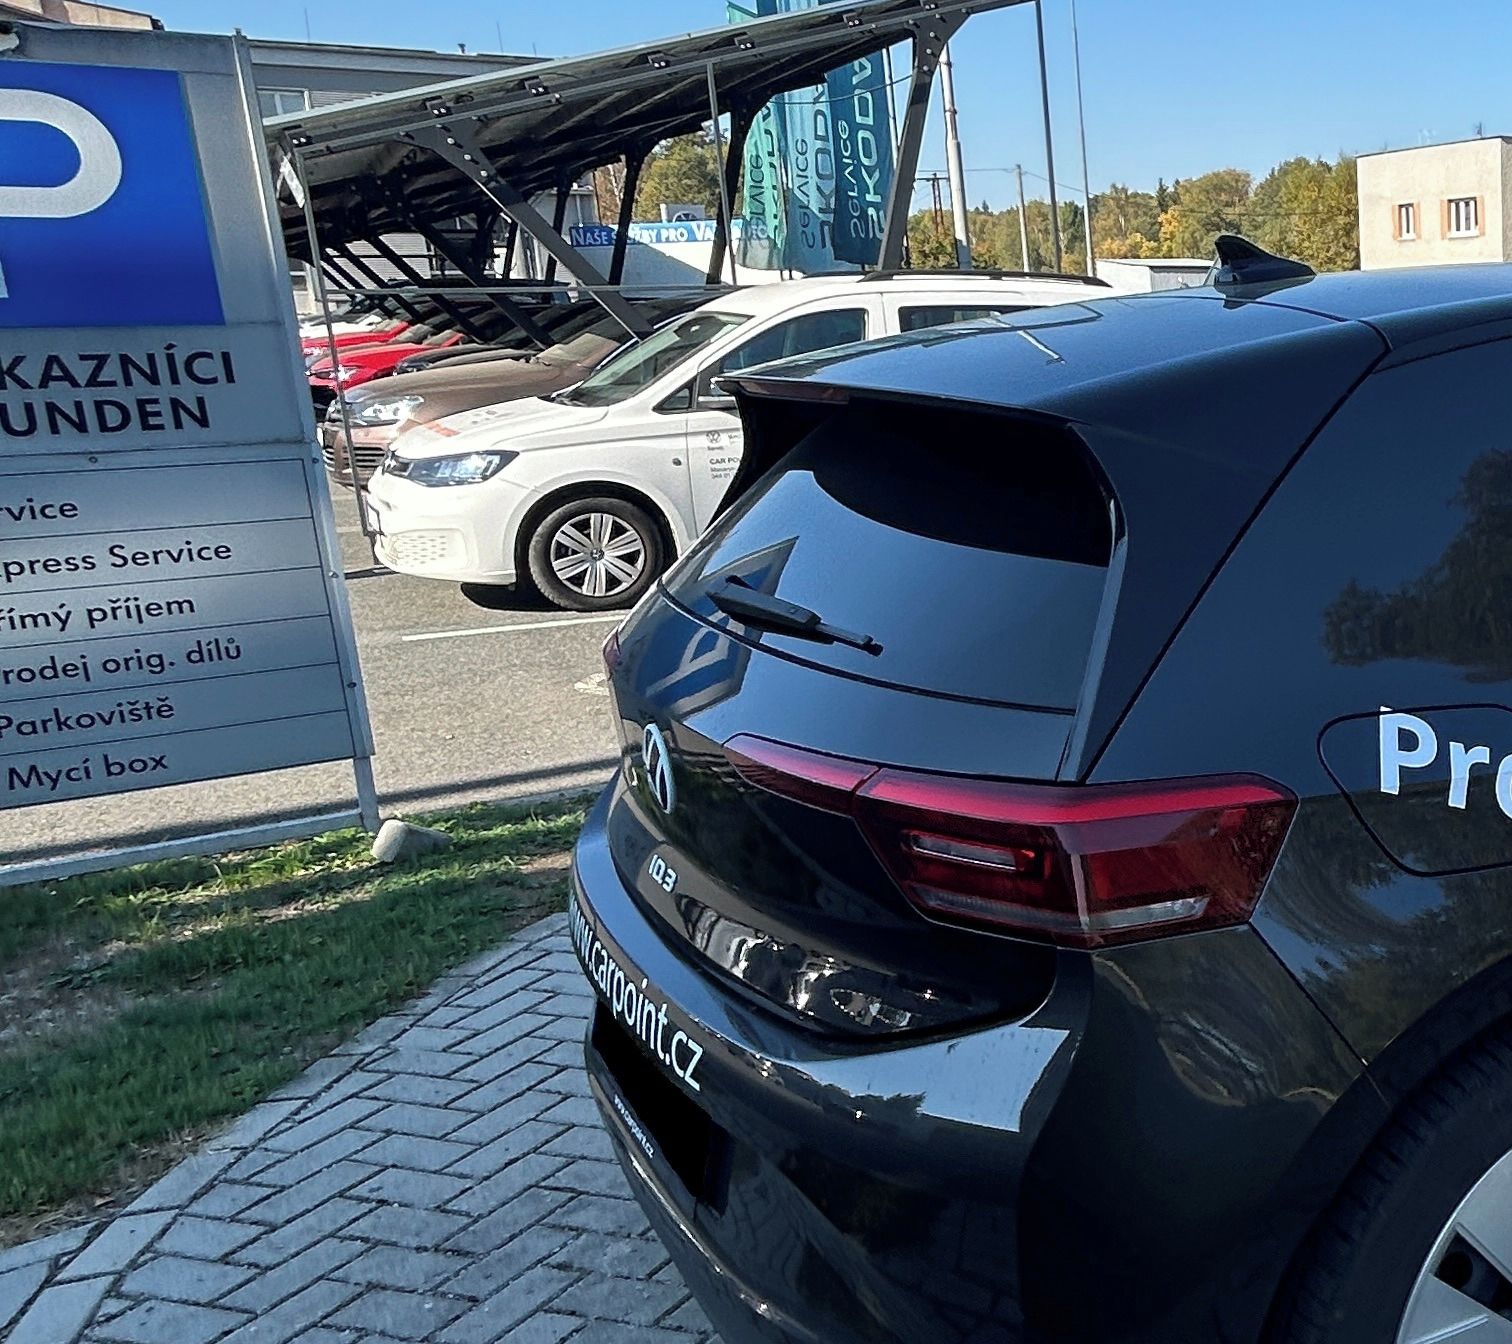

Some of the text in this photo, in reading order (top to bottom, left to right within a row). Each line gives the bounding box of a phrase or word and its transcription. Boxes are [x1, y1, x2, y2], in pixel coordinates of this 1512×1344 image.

[0, 89, 122, 298] P
[0, 343, 236, 390] KAZNÍCI
[0, 395, 210, 437] UNDEN
[0, 498, 79, 521] vice
[0, 540, 232, 583] press Service
[86, 597, 196, 629] příjem
[102, 648, 177, 675] orig.
[186, 637, 242, 665] dílů
[0, 696, 175, 739] Parkoviště
[8, 753, 169, 792] Mycí box
